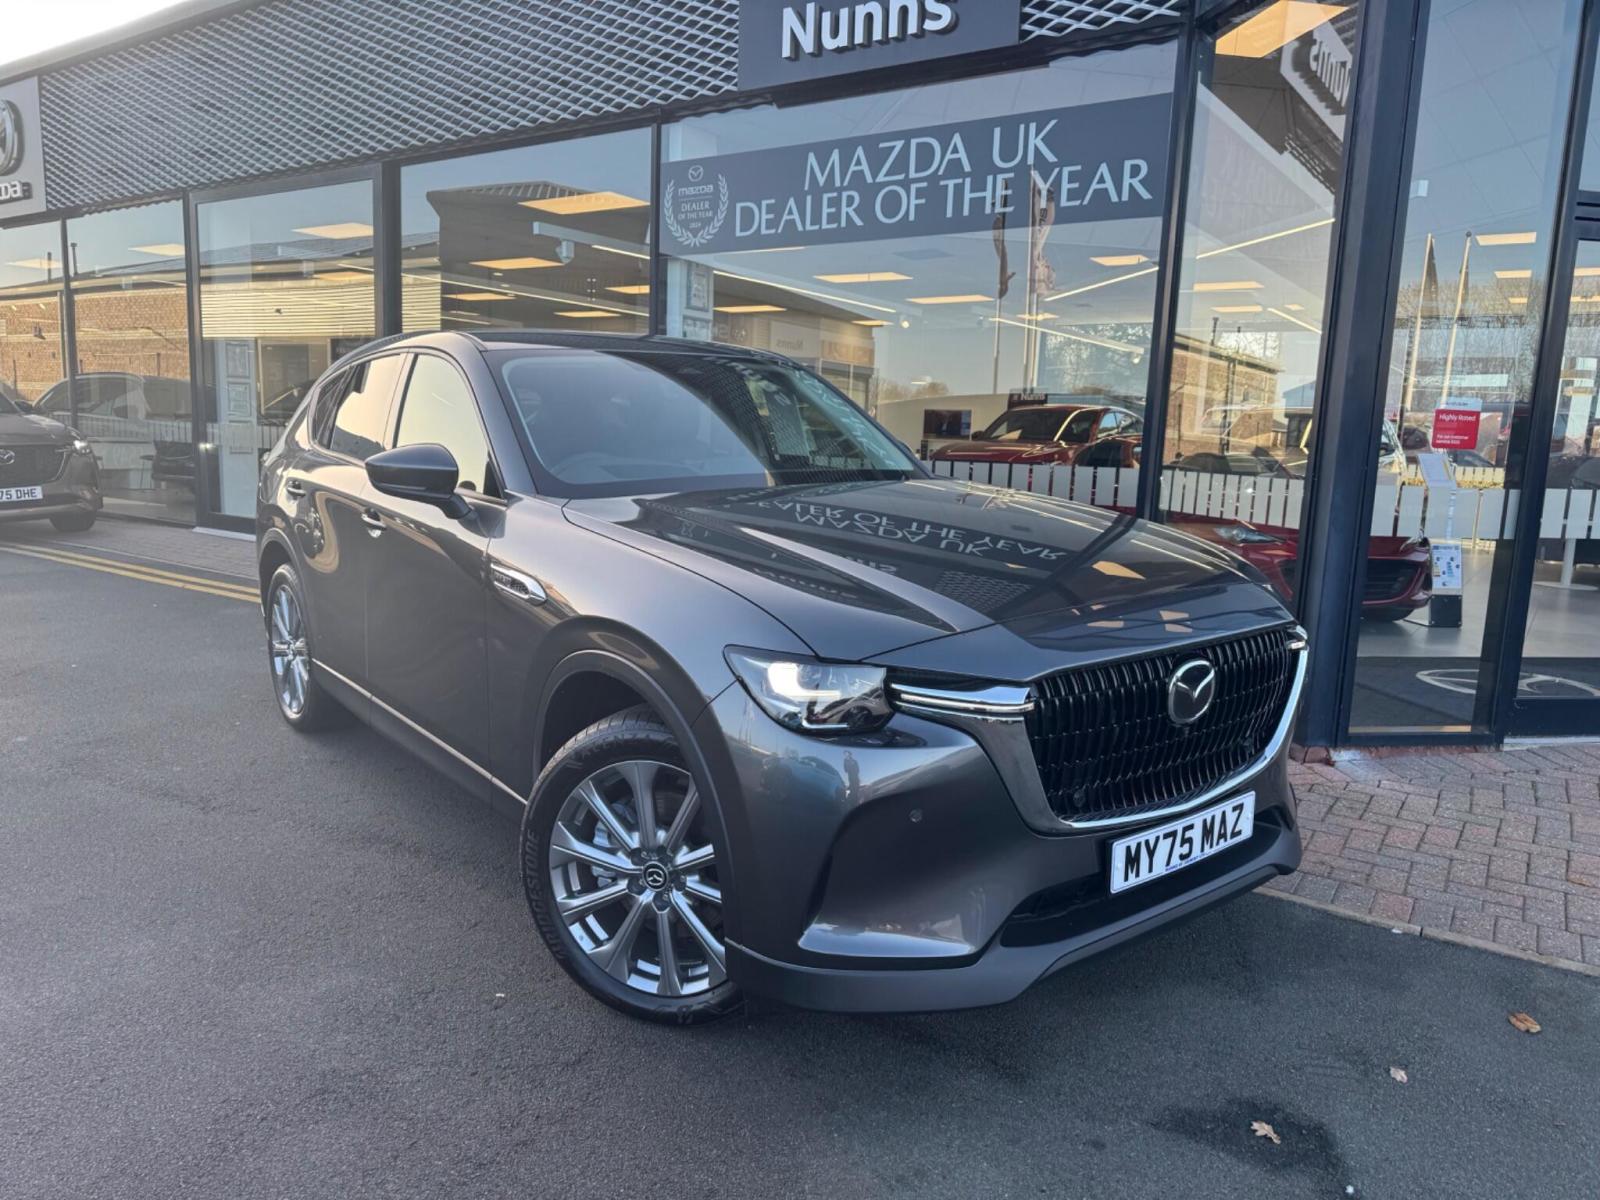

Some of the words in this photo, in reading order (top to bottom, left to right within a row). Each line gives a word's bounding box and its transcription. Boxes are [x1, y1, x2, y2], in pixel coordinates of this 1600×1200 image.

[781, 0, 955, 58] Nunns
[804, 132, 971, 190] MAZDA
[992, 119, 1058, 168] UK
[681, 200, 710, 212] DEALER
[735, 190, 864, 237] DEALER
[874, 182, 928, 224] OF
[940, 172, 1015, 218] THE
[1031, 158, 1153, 209] YEAR
[15, 488, 37, 499] DHE
[1124, 823, 1195, 882] MY75
[1200, 802, 1244, 853] MAZ
